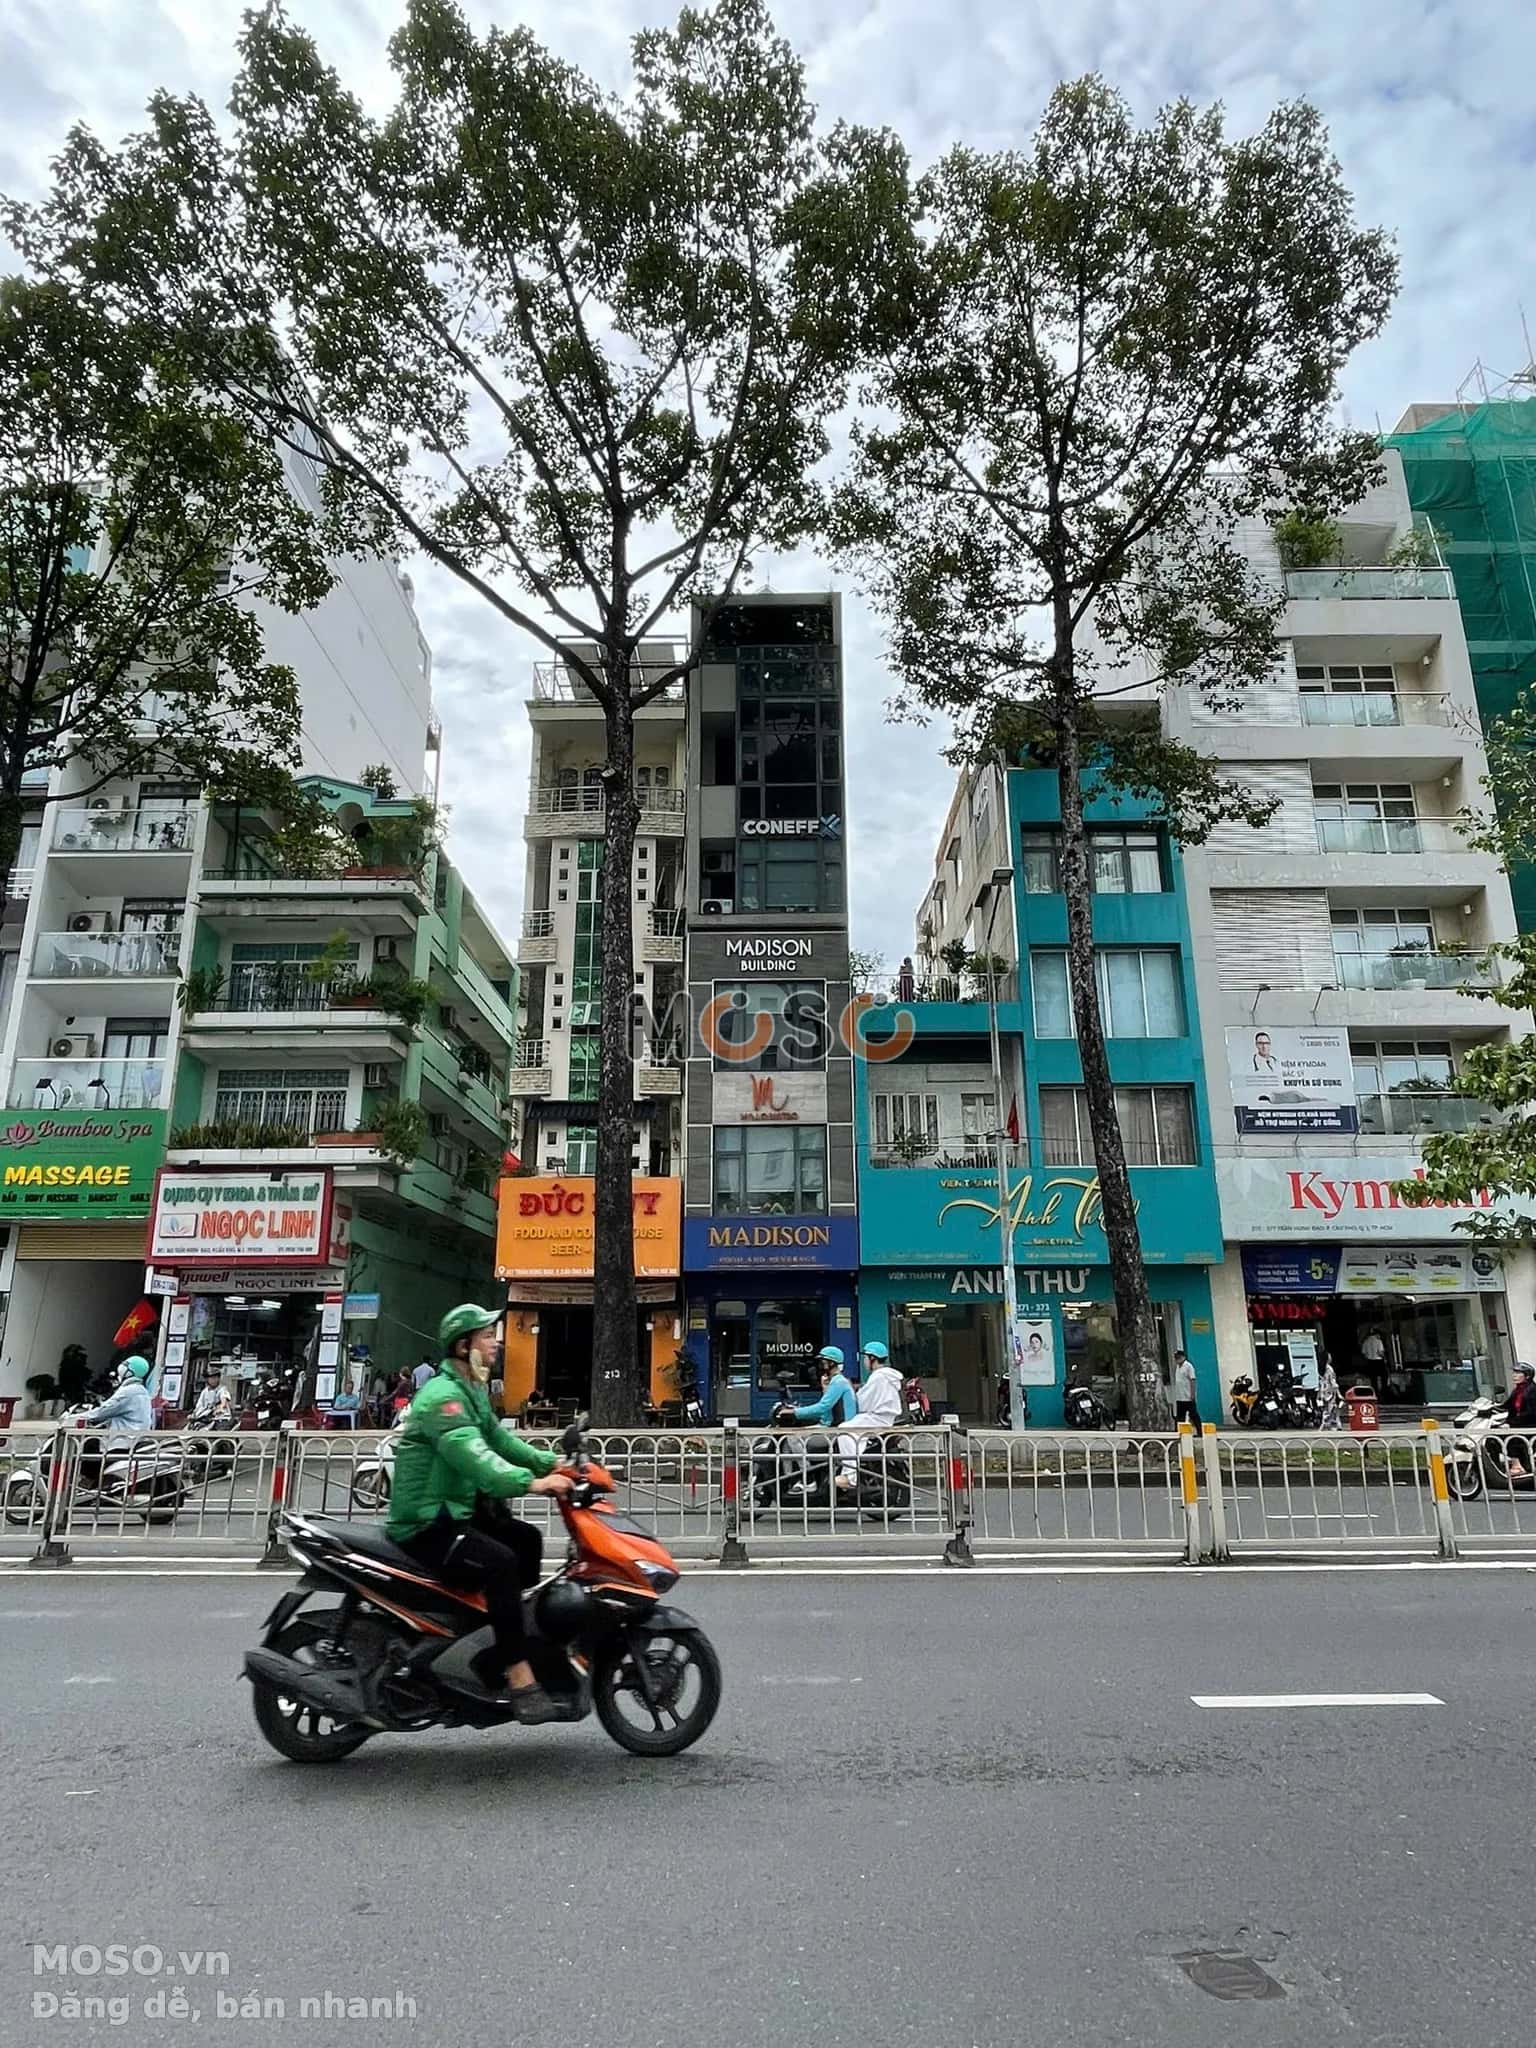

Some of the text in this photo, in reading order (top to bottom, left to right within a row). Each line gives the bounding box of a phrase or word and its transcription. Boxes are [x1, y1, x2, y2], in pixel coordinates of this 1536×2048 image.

[726, 938, 812, 957] MADISON
[740, 959, 797, 972] BUILDING
[38, 1116, 153, 1143] Bamboo Spa
[4, 1165, 131, 1185] MASSAGE
[519, 1183, 585, 1217] ĐỨC
[1043, 1175, 1140, 1240] Th
[201, 1209, 317, 1246] NGỌC LINH
[513, 1227, 546, 1240] FOOD
[549, 1227, 573, 1240] AND
[708, 1225, 832, 1247] MADISON
[551, 1244, 583, 1257] BEER
[234, 1279, 315, 1291] NGỌC LINH
[1023, 1268, 1092, 1295] THƯ
